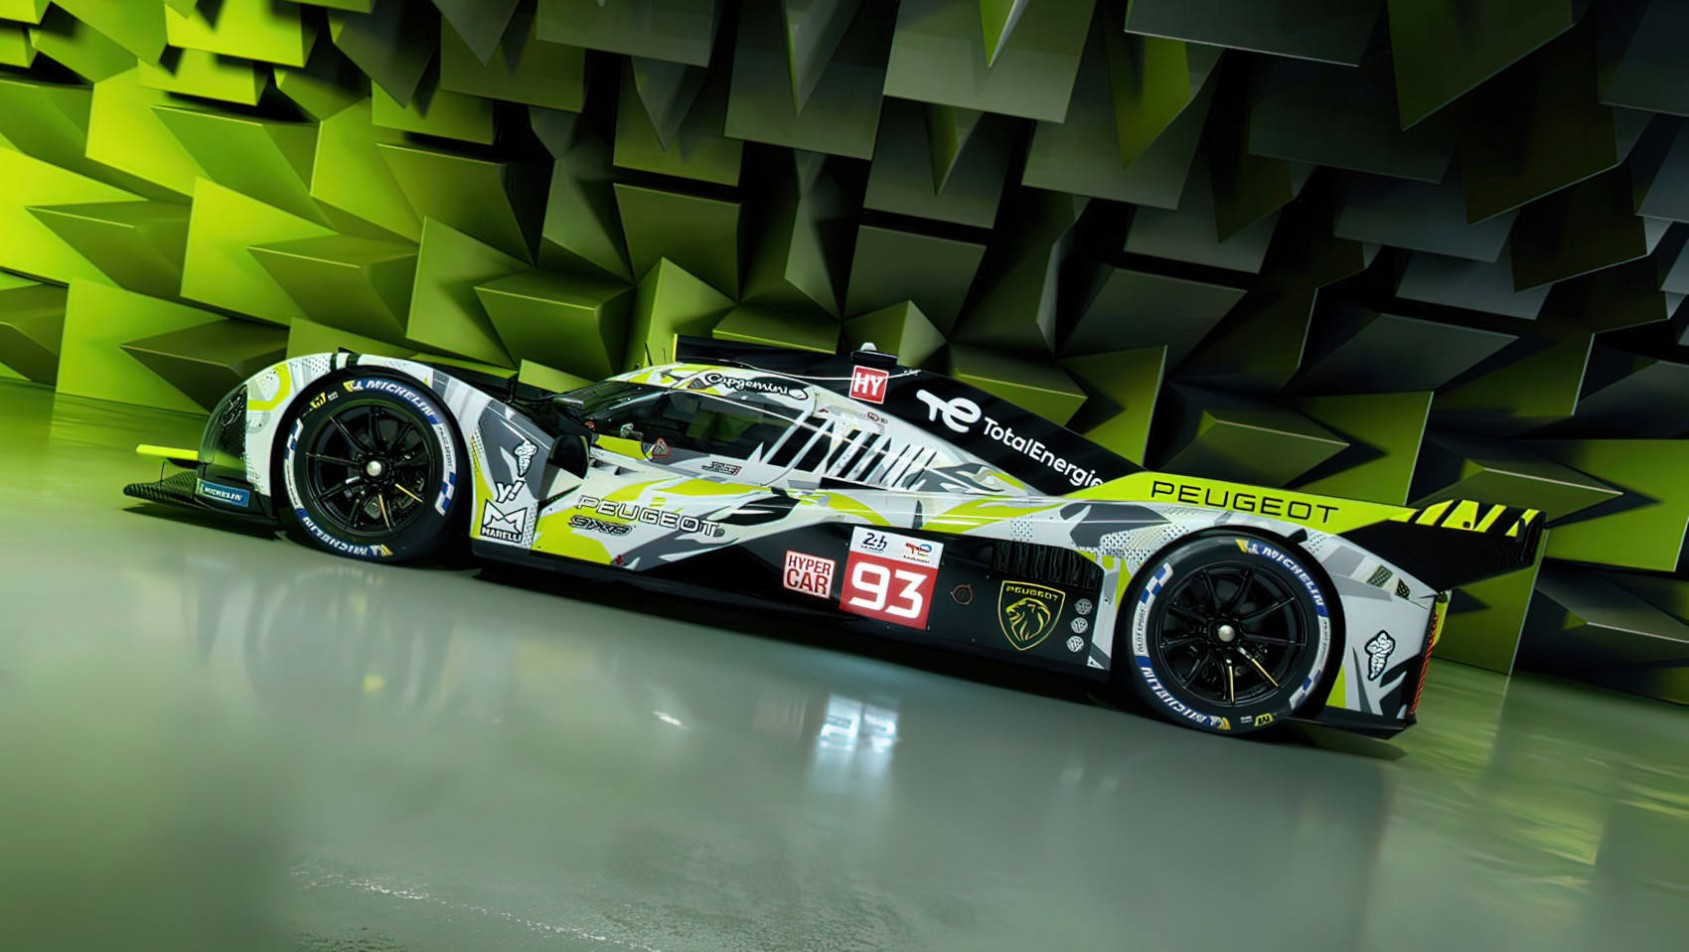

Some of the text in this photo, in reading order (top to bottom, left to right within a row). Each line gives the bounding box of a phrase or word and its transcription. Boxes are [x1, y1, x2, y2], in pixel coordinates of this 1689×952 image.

[365, 380, 435, 417] MICHELIN
[853, 372, 884, 397] HY
[576, 495, 719, 538] PEUGEOT
[1151, 481, 1339, 523] PEUGEOT
[302, 517, 369, 557] MICHELIN
[481, 526, 523, 543] MARELLI
[786, 567, 829, 596] CAR
[787, 554, 832, 577] HYPER
[1262, 549, 1325, 607] MICHELIN
[848, 561, 928, 619] 93
[1006, 585, 1059, 601] PEUGEOT
[1140, 666, 1208, 723] MICHELIN
